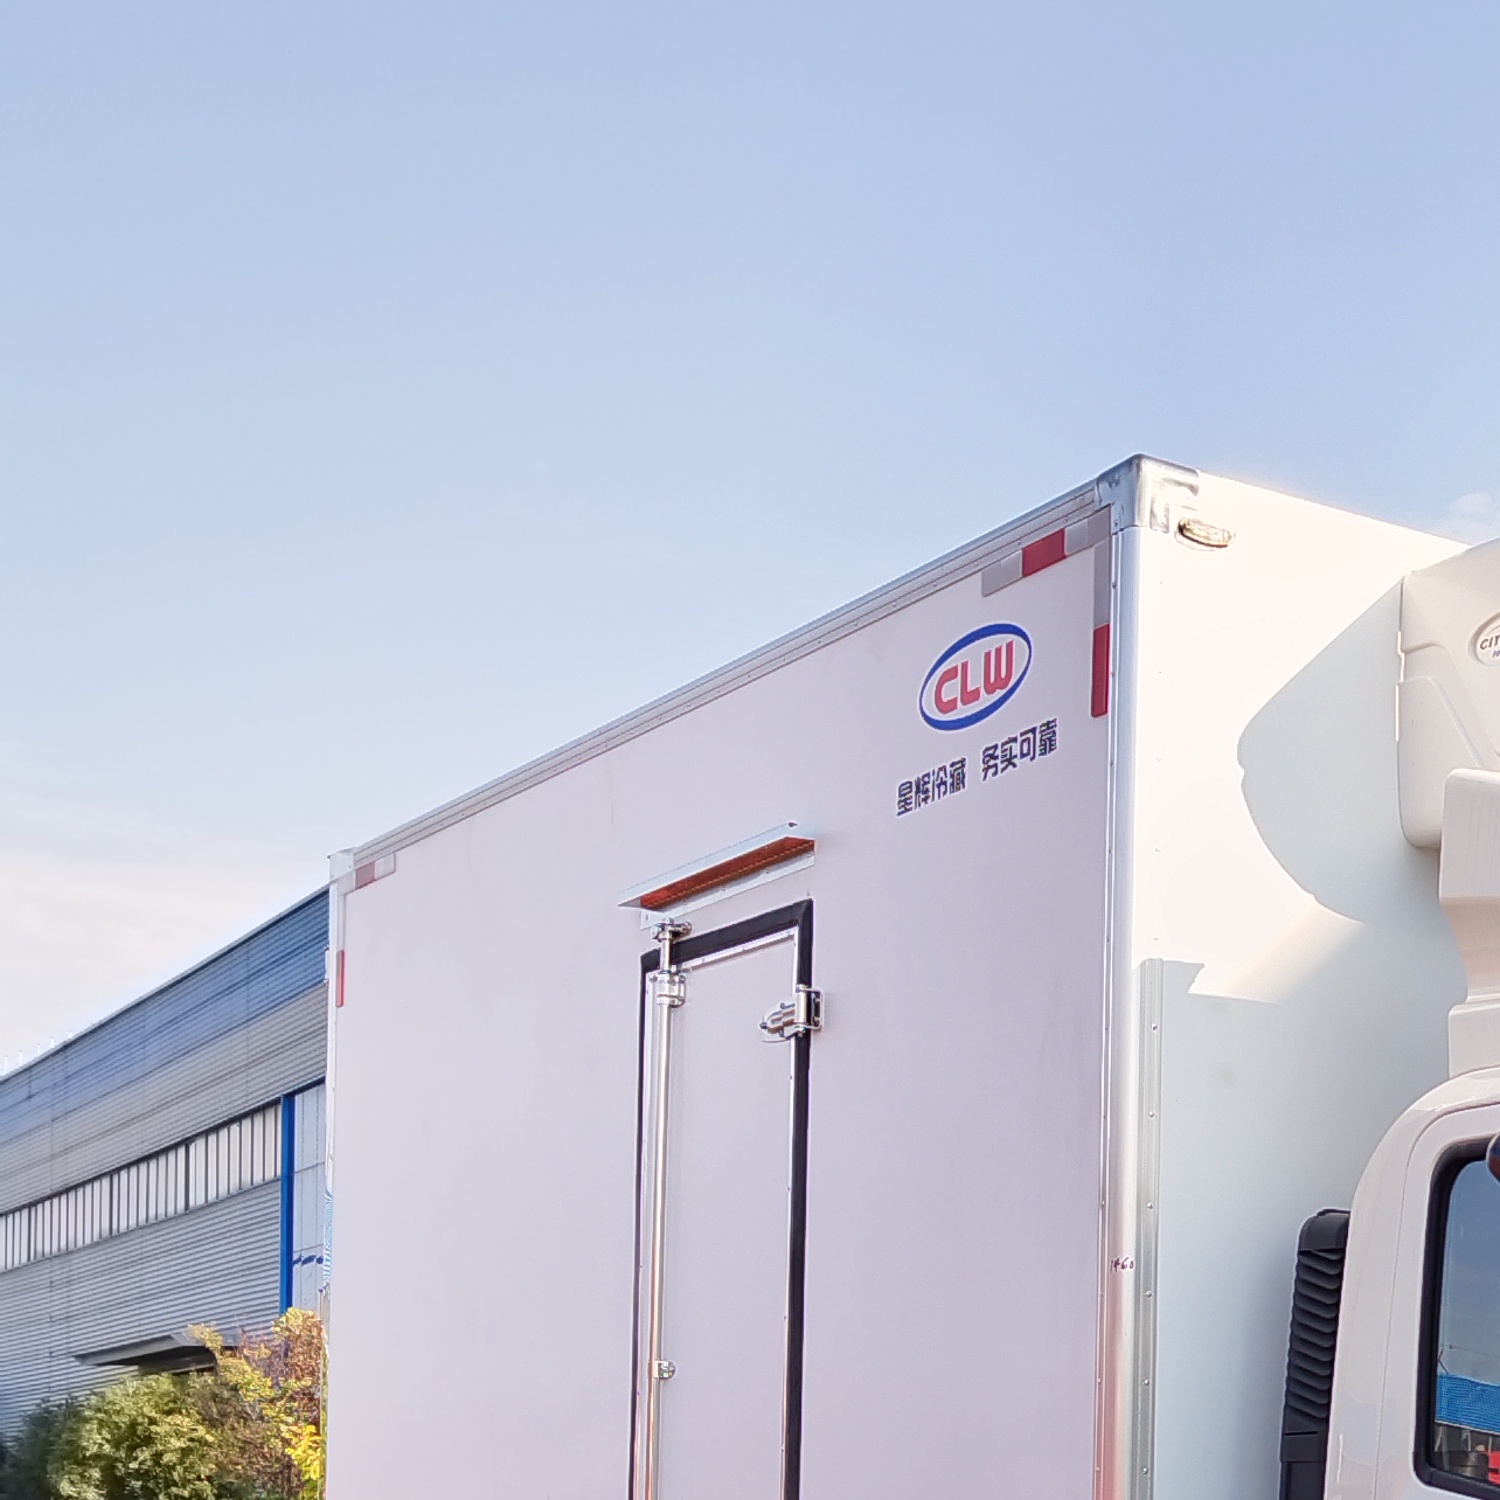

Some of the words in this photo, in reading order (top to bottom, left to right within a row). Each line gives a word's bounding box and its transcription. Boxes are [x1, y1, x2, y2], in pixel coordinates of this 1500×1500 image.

[934, 640, 1014, 714] CLW
[896, 757, 967, 817] 星辉冷藏
[981, 717, 1058, 782] 务实可靠
